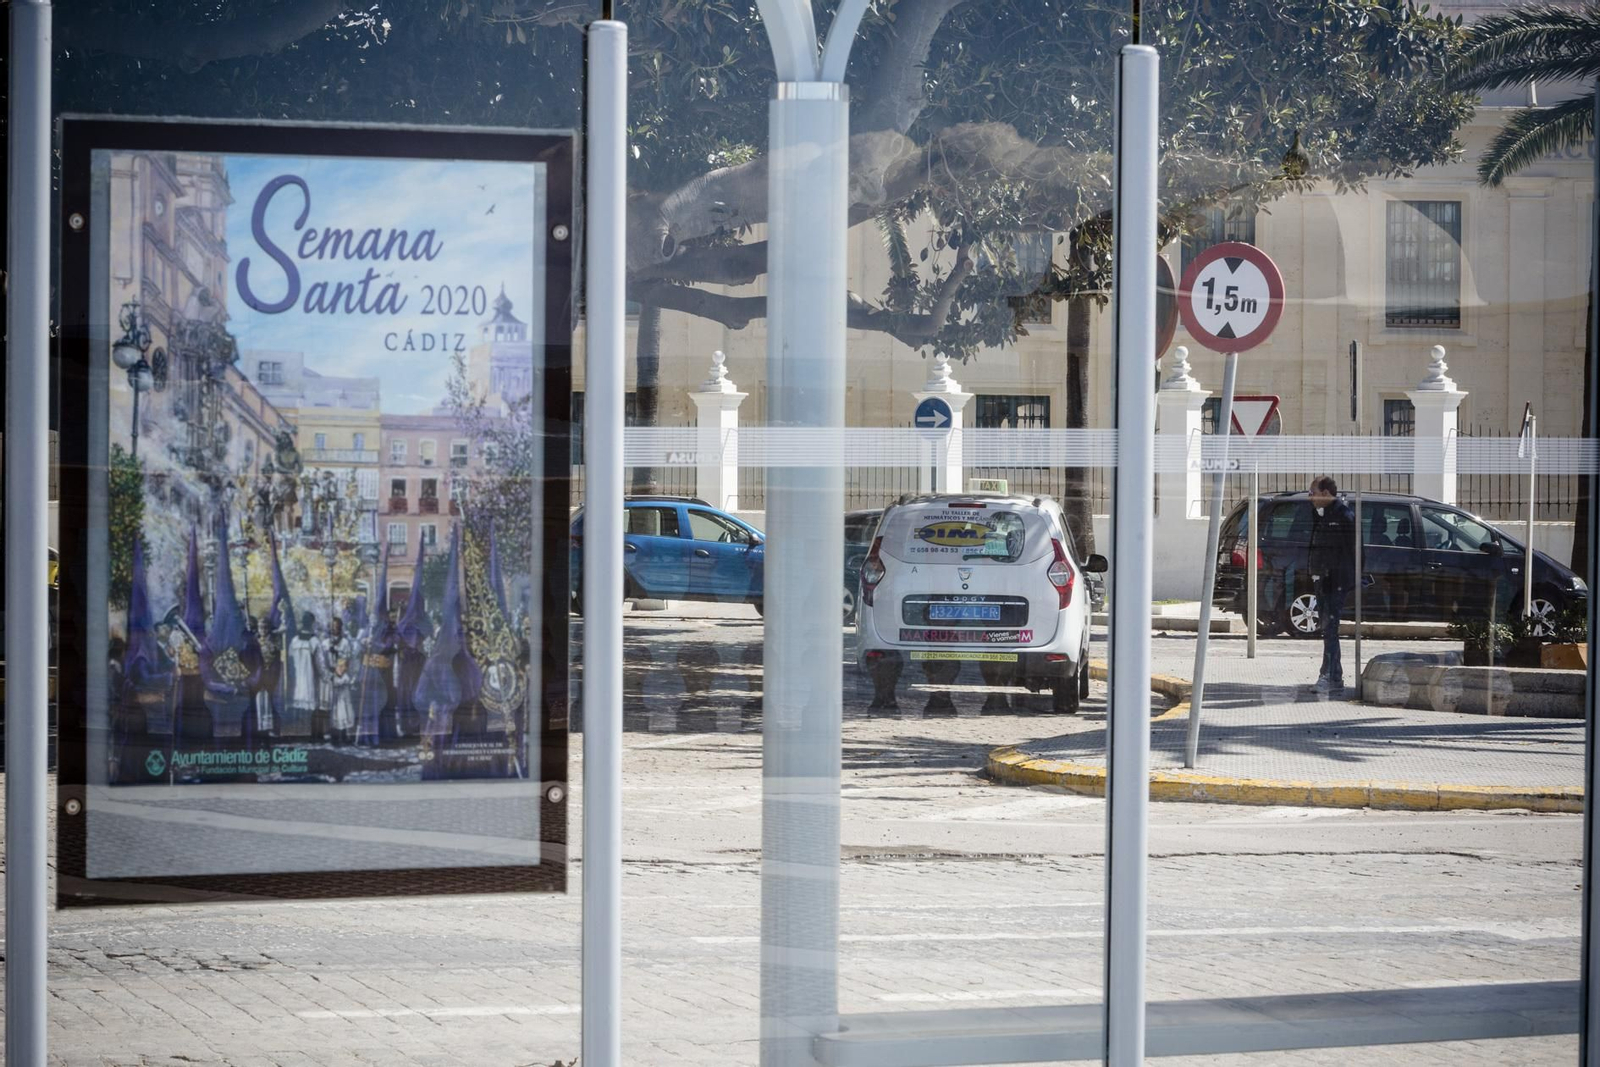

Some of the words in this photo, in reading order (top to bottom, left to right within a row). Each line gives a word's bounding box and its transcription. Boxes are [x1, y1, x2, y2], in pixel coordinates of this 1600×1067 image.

[236, 174, 443, 314] Semana
[421, 285, 487, 315] 2020
[384, 329, 466, 352] CÁDIZ
[911, 566, 918, 574] A
[938, 607, 969, 618] 3274
[973, 607, 996, 618] LFR
[901, 630, 989, 641] MARRUZELLA
[1021, 632, 1031, 641] M
[171, 751, 253, 767] Ayuntamiento
[255, 751, 270, 764] de
[273, 748, 308, 763] Cádiz
